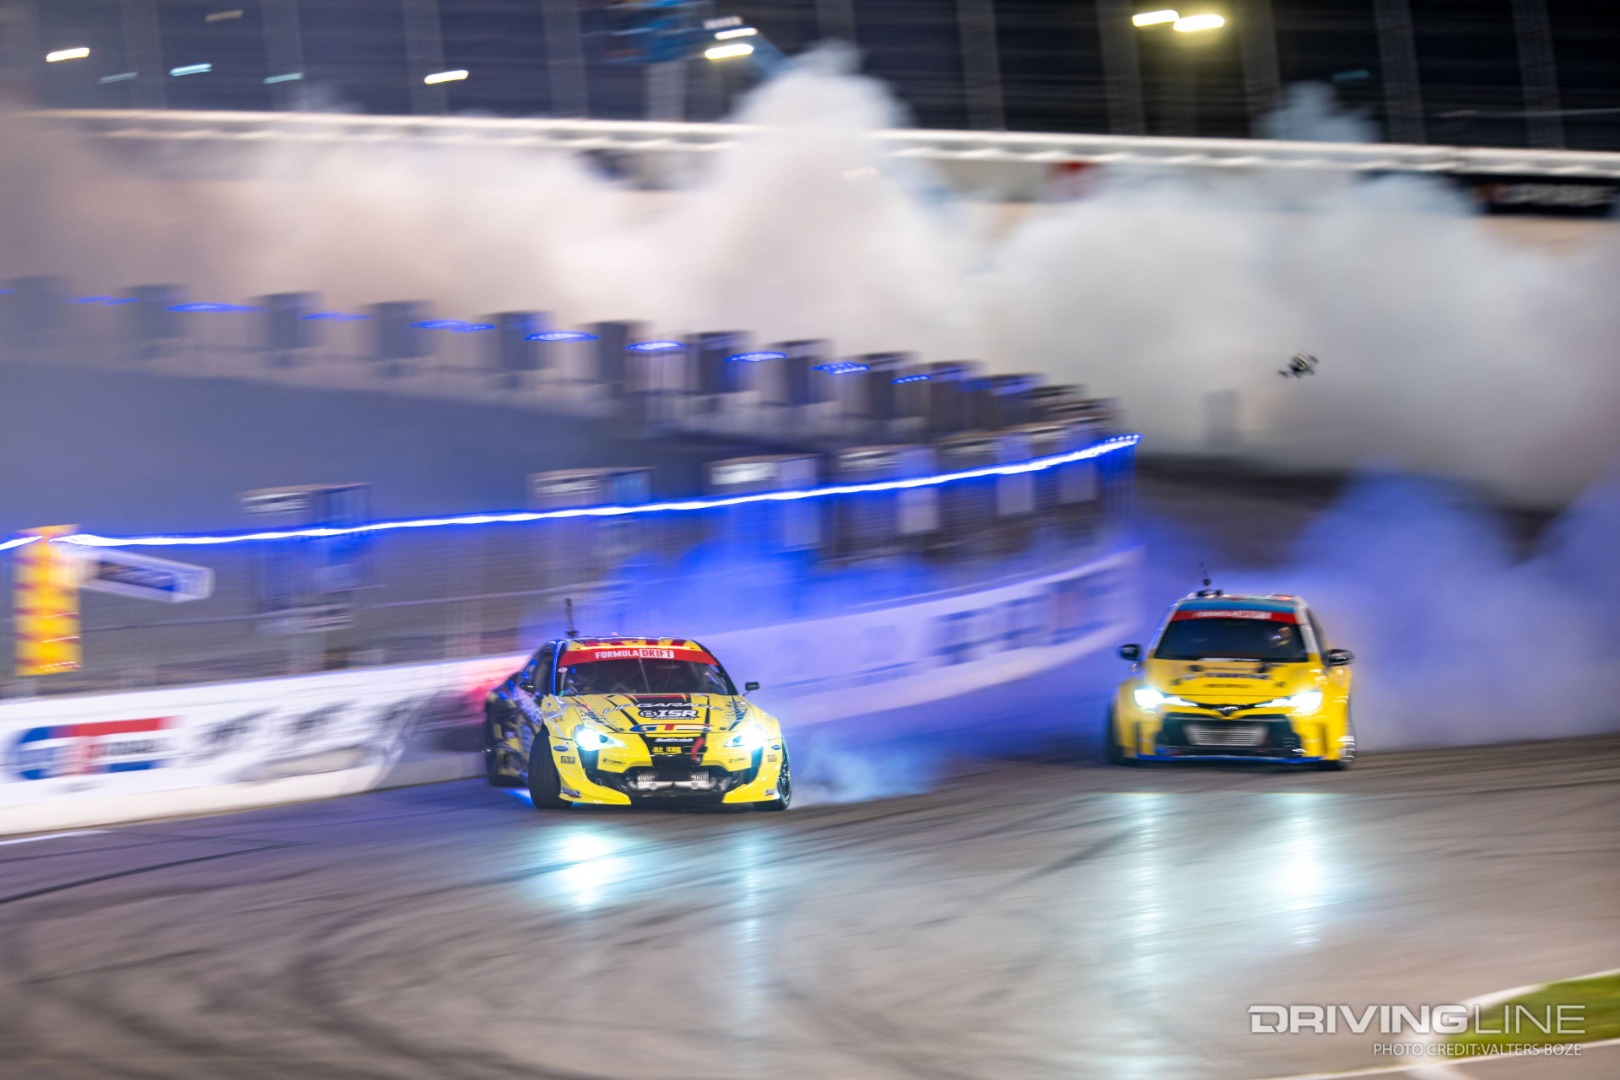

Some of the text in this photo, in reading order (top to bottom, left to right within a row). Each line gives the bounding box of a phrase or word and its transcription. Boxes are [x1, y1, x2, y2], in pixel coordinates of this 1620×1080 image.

[595, 649, 675, 659] FORMULA DRIFT
[657, 709, 698, 718] ISR
